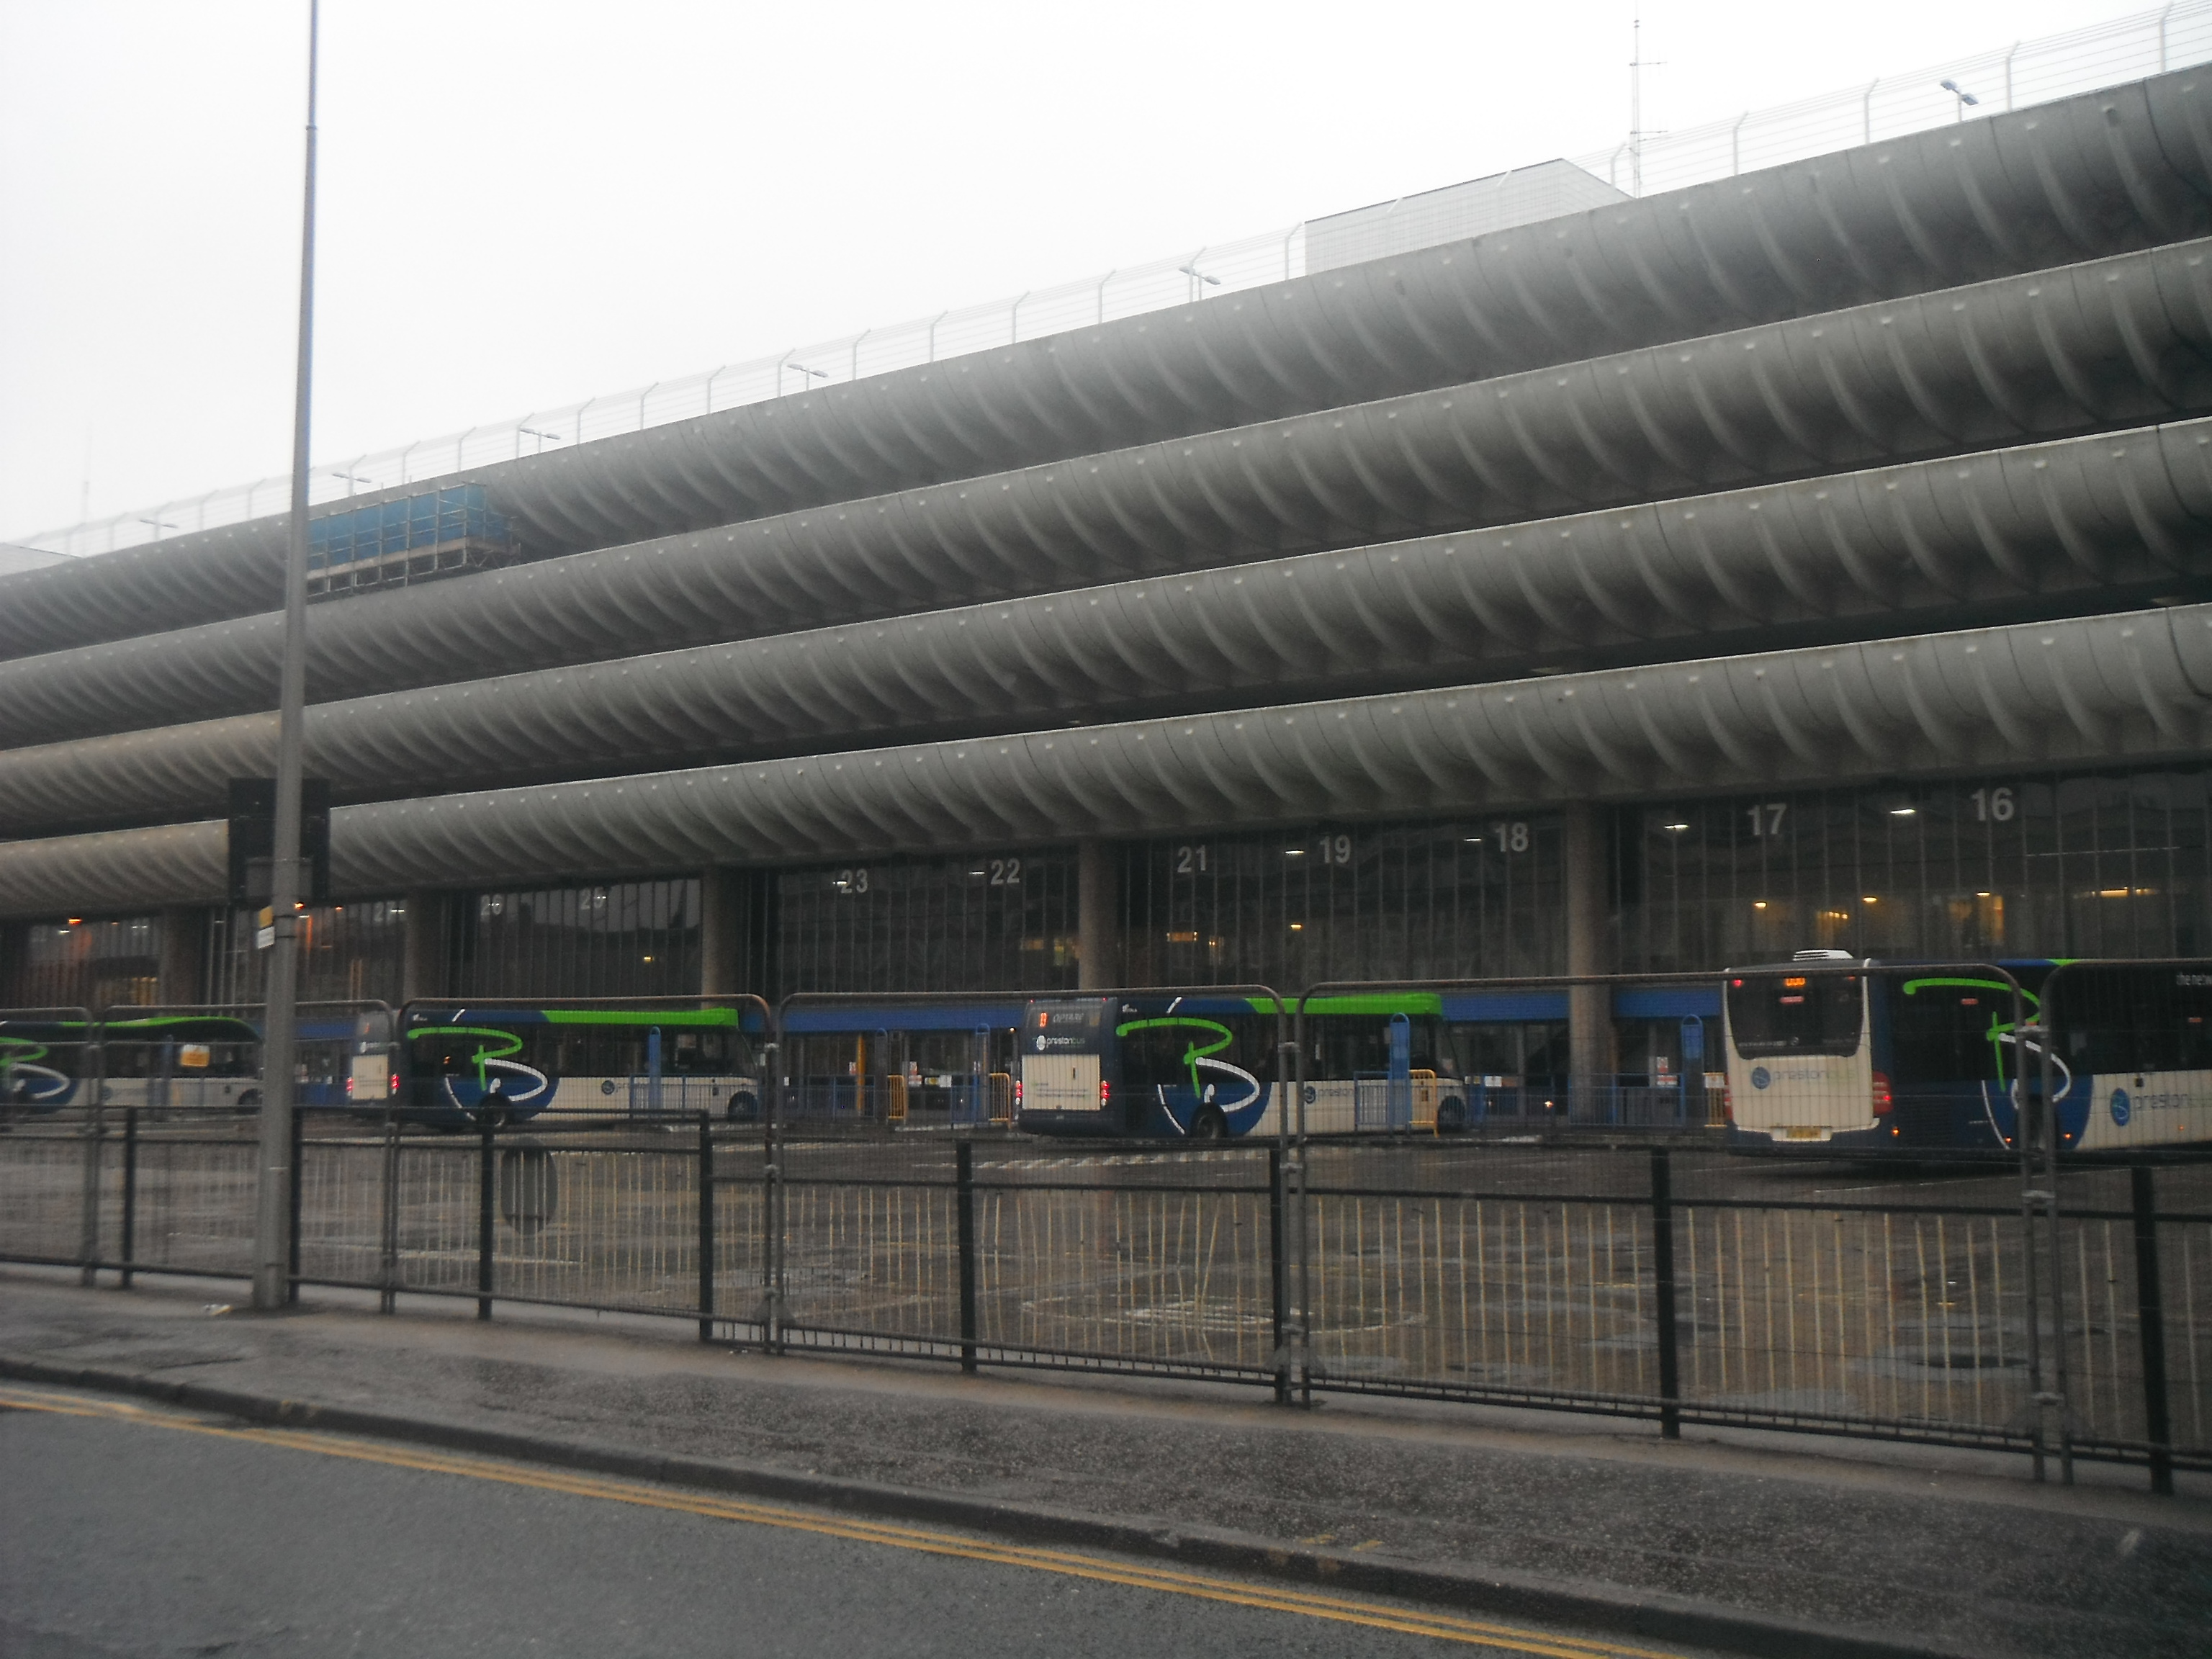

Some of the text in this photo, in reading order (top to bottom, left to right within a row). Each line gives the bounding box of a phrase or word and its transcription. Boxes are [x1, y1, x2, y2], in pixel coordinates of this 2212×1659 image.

[1972, 786, 2015, 821] 16
[1746, 803, 1787, 836] 17
[1319, 834, 1352, 864] 19
[1493, 822, 1529, 853] 18
[990, 857, 1021, 886] 22
[1177, 844, 1207, 873] 21
[840, 868, 868, 894] 23
